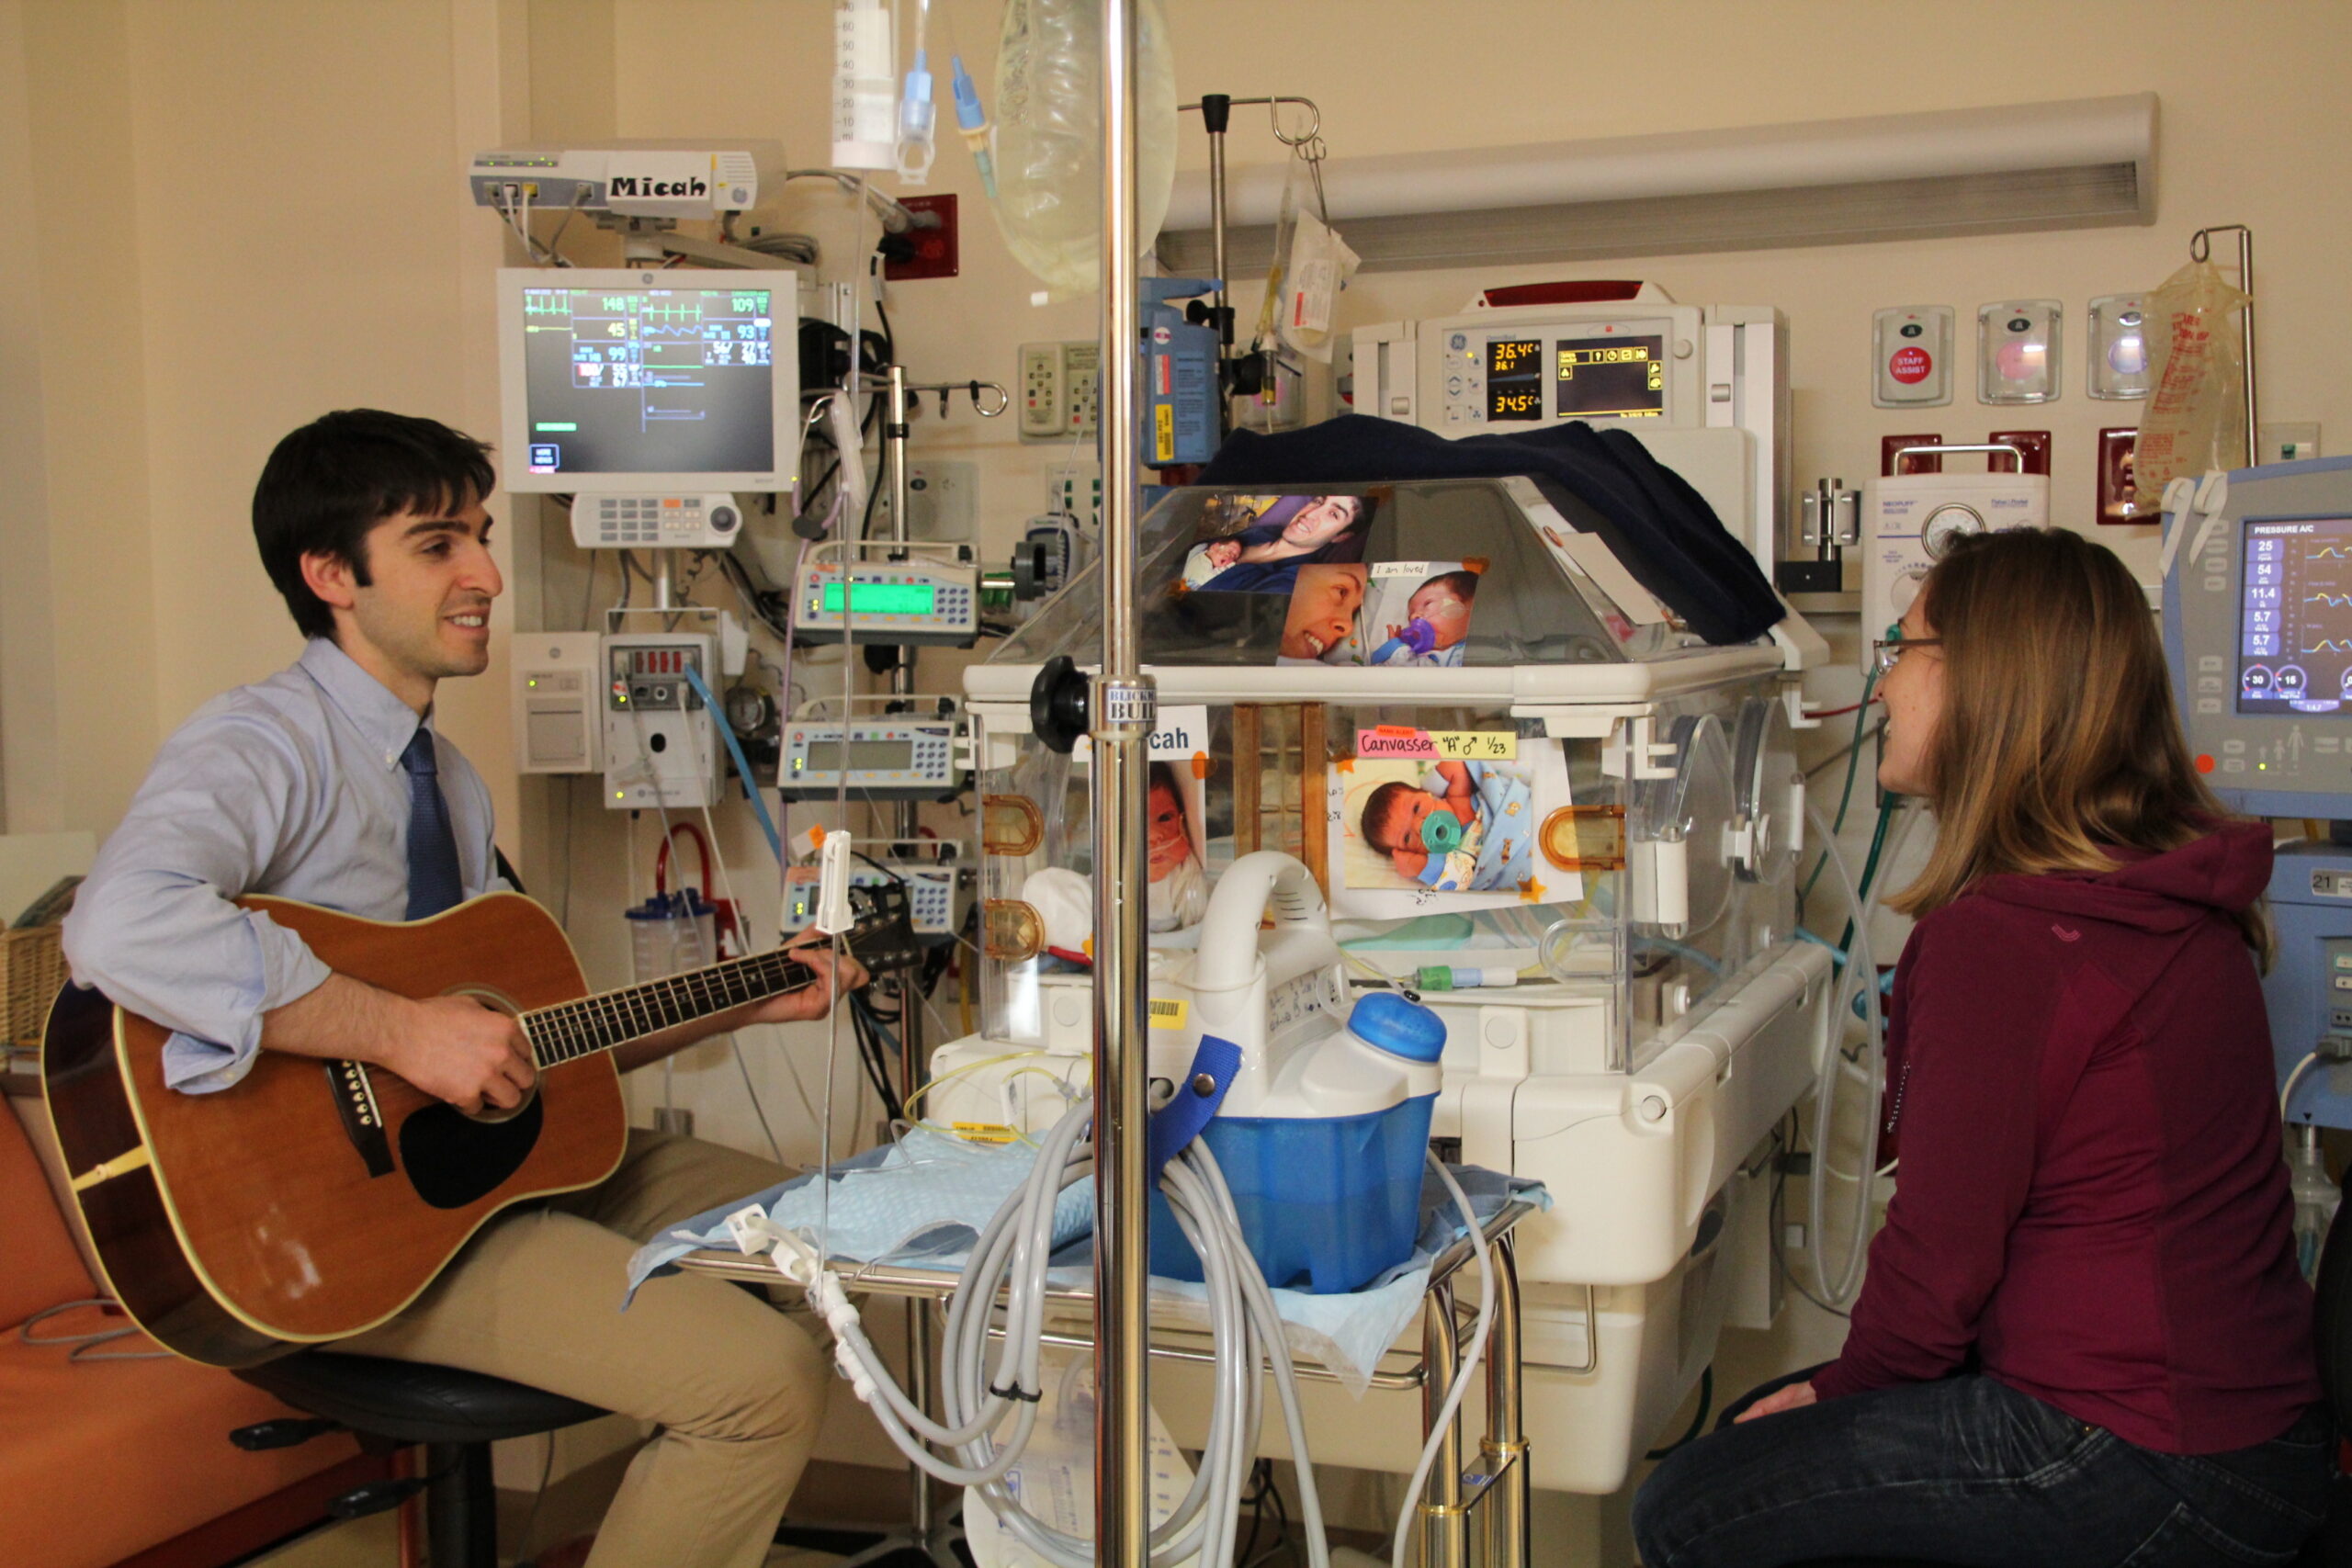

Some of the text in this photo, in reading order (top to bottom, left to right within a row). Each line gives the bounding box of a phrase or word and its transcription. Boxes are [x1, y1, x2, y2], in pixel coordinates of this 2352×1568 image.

[842, 22, 854, 32] 60
[842, 41, 854, 51] 50
[842, 61, 854, 70] 40
[842, 80, 854, 89] 30
[842, 98, 854, 108] 20
[842, 118, 854, 127] 10
[610, 176, 707, 197] Micah
[731, 298, 754, 312] 109
[607, 322, 627, 337] 45
[737, 324, 755, 339] 93
[607, 346, 627, 361] 99
[1896, 356, 1925, 366] STAFF
[1894, 366, 1926, 375] ASSIST
[2255, 525, 2314, 535] PRESSURE A/C
[2258, 541, 2273, 551] 25
[1376, 565, 1381, 574] I
[1403, 563, 1424, 574] loved
[2257, 564, 2271, 575] 54
[2252, 588, 2276, 599] 11.4
[2254, 611, 2271, 622] 5.7
[2253, 635, 2270, 646] 5.7
[2252, 675, 2264, 684] 30
[1110, 691, 1156, 701] BLICKM
[1111, 703, 1156, 718] BUIL
[1149, 728, 1189, 750] cah
[1362, 735, 1438, 752] Canvasser
[2312, 874, 2330, 889] 21
